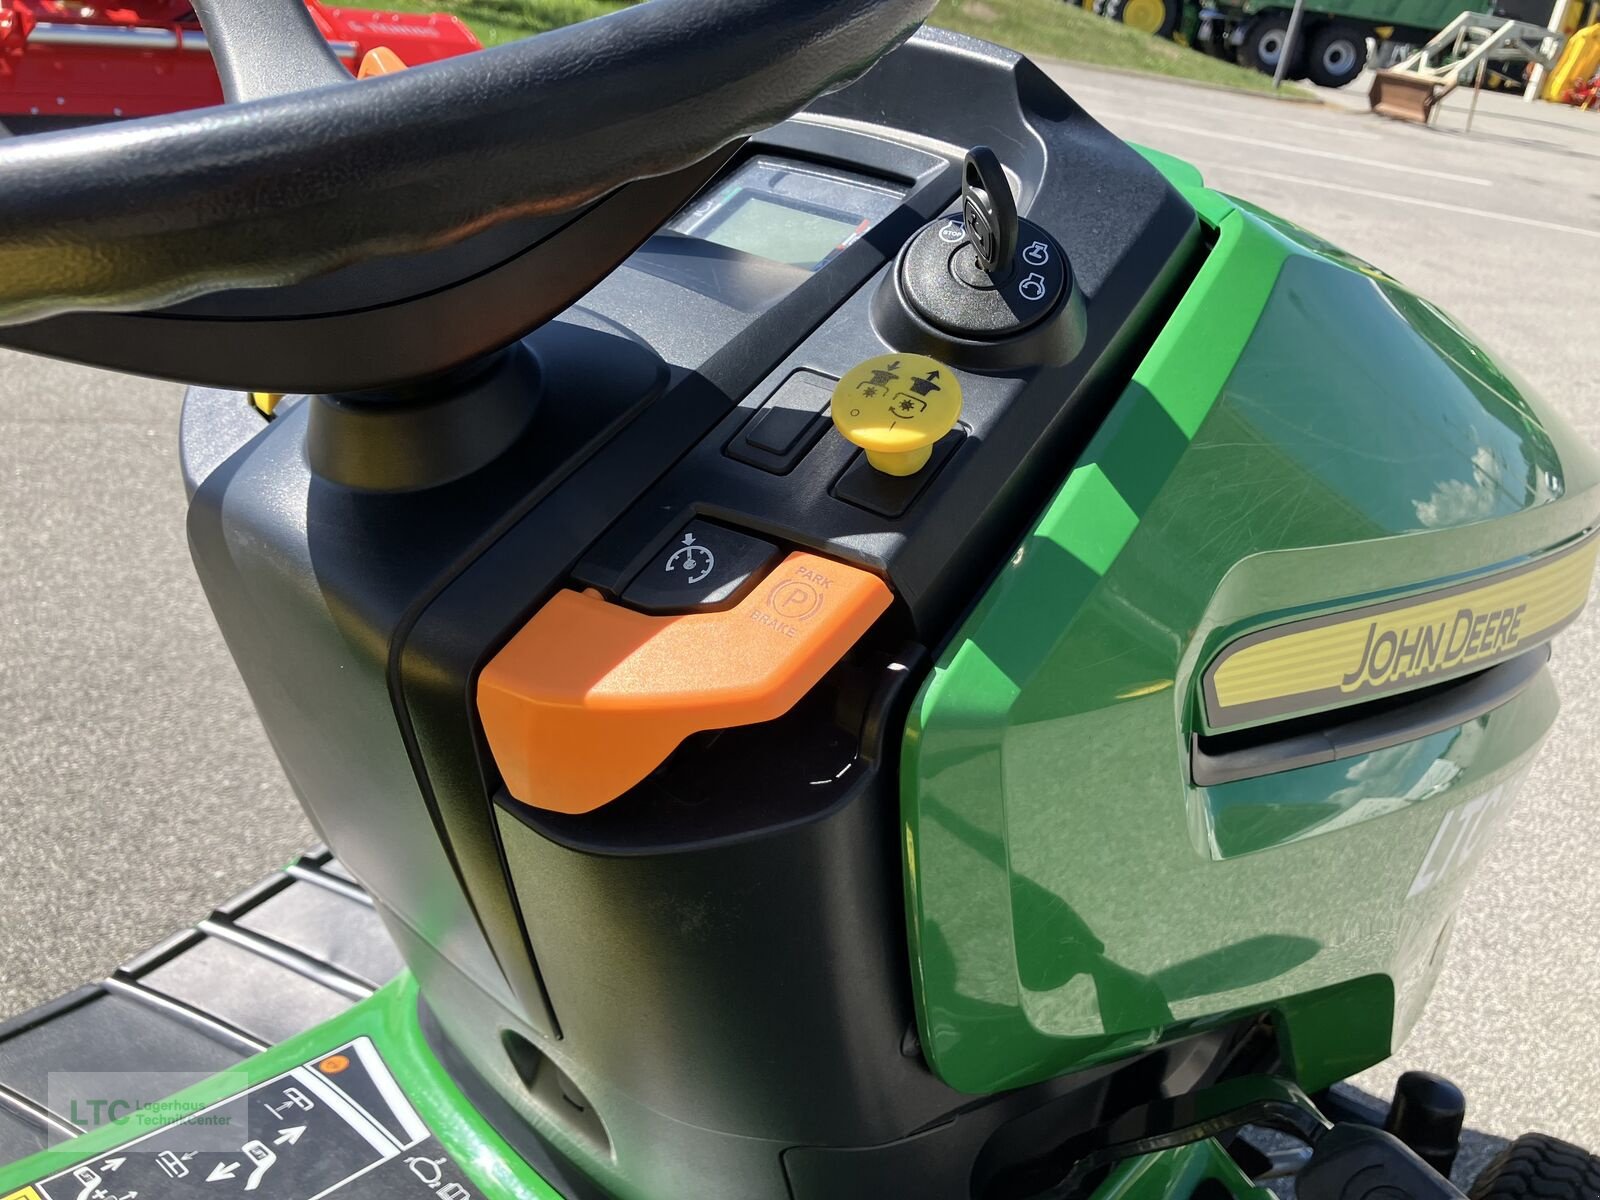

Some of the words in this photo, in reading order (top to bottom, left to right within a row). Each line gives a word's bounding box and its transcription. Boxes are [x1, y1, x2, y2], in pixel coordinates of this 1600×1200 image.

[942, 229, 963, 237] STOP
[795, 566, 834, 590] PARK
[782, 588, 809, 608] P
[750, 609, 797, 639] BRAKE
[1341, 622, 1446, 688] JOHN
[1443, 603, 1527, 664] DEERE
